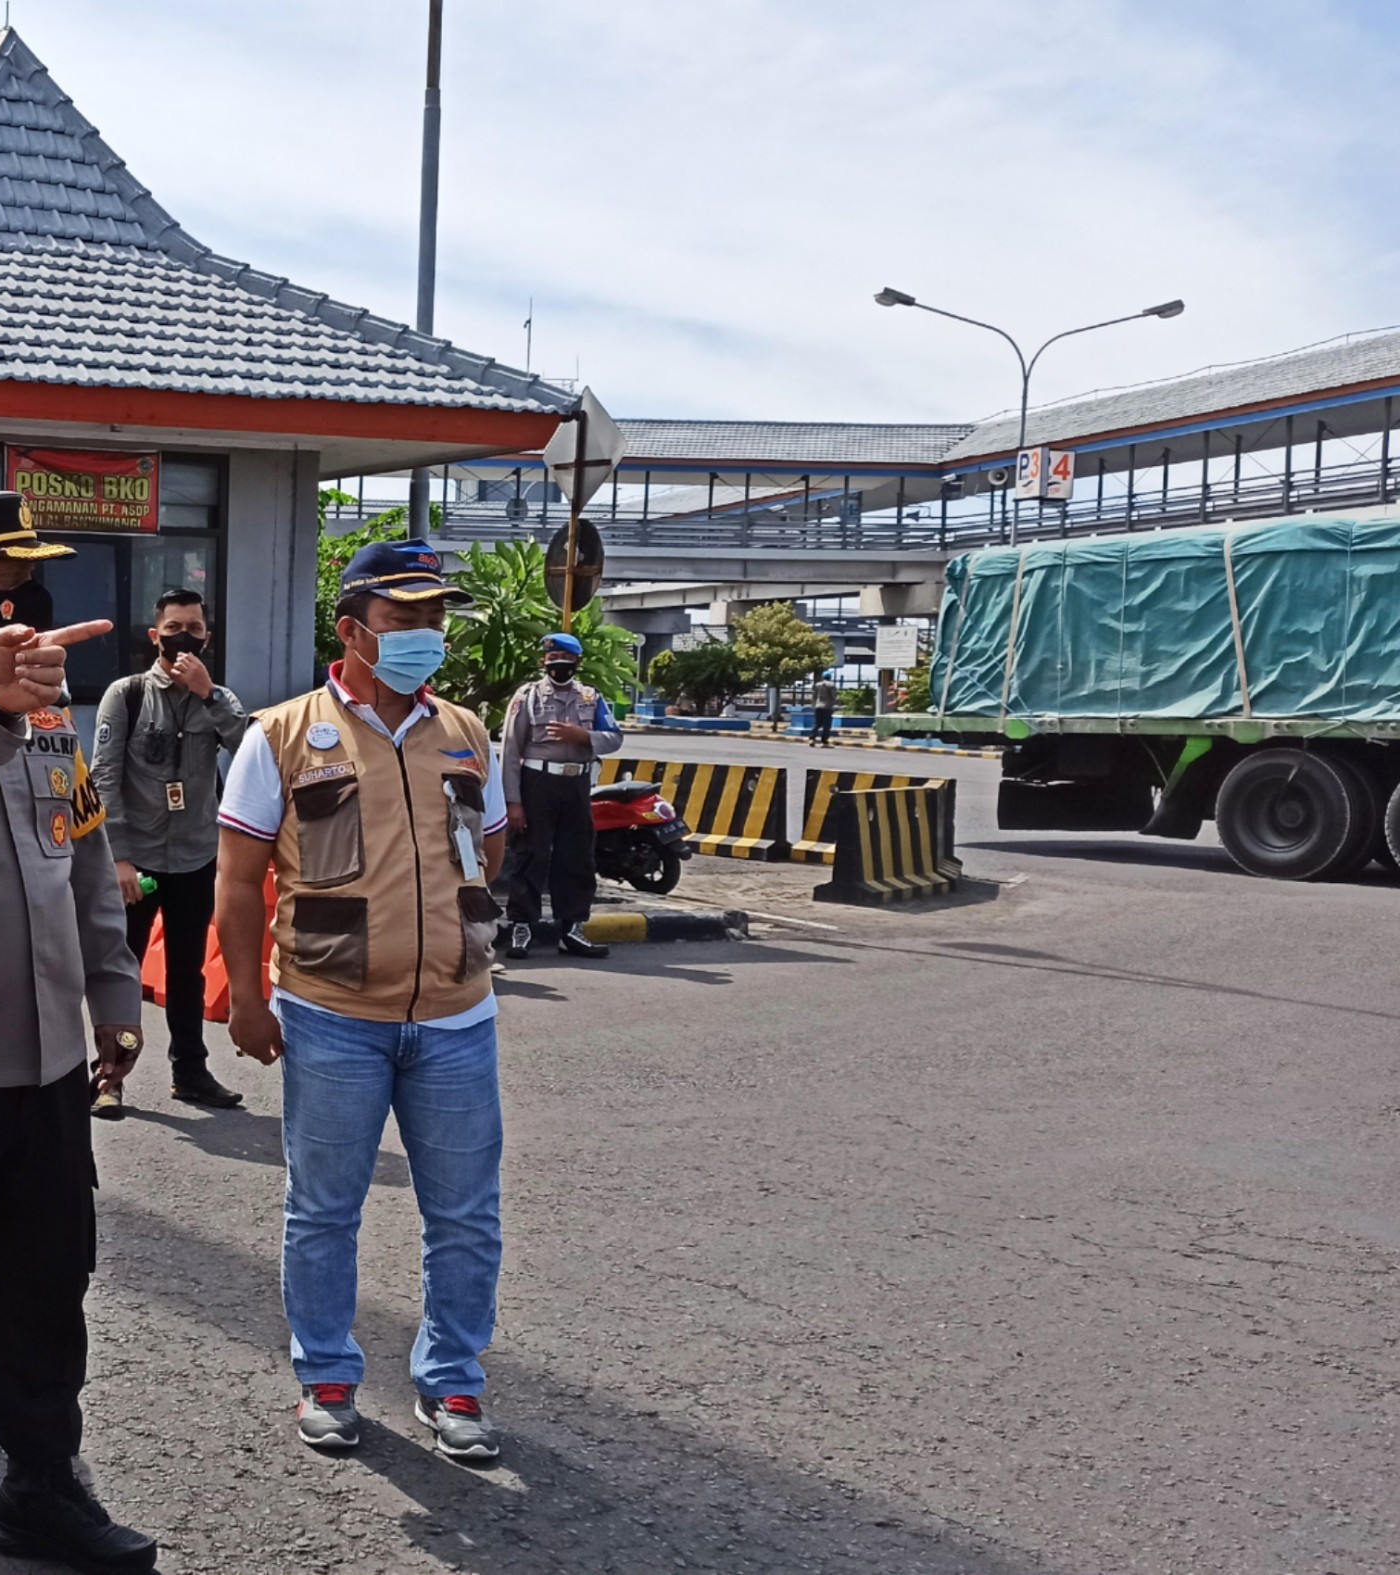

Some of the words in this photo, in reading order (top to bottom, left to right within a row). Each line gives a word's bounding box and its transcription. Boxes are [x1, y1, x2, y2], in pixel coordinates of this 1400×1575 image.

[15, 470, 96, 499] POSKO
[102, 474, 150, 502] BKO
[121, 504, 150, 517] ASDP
[298, 765, 346, 783] SUHARTO
